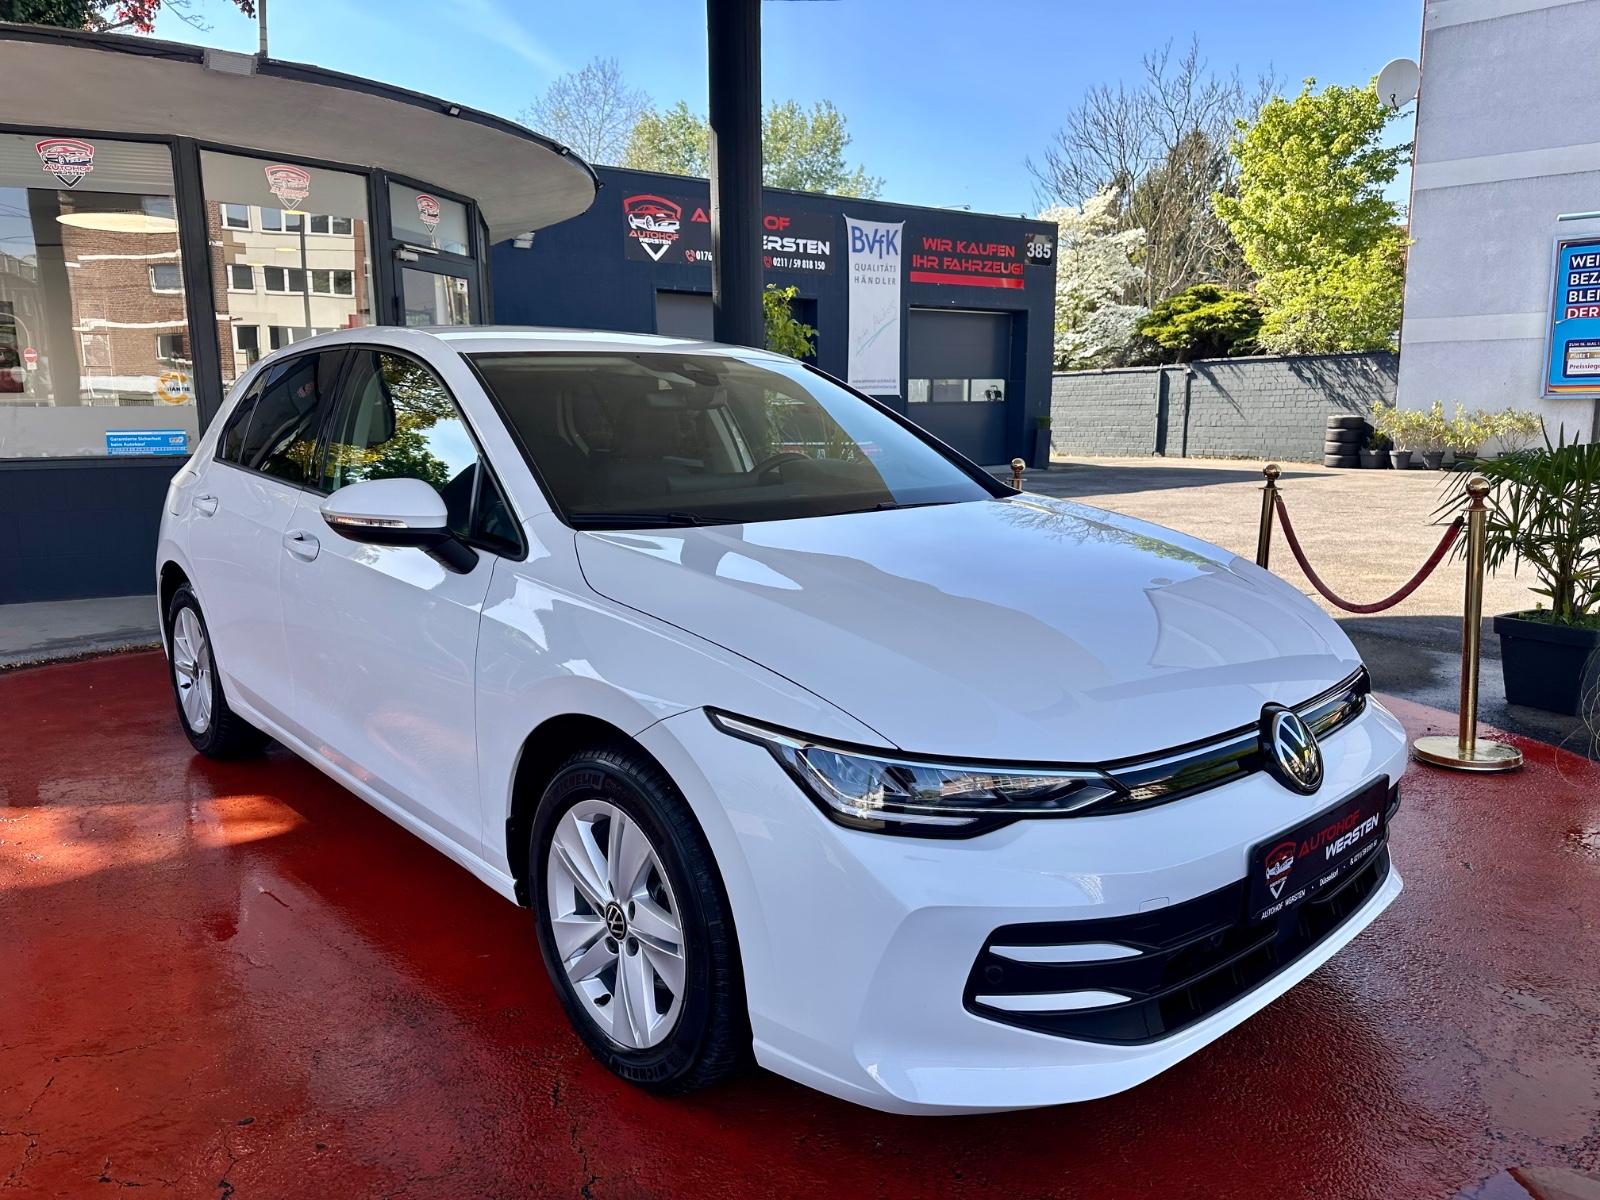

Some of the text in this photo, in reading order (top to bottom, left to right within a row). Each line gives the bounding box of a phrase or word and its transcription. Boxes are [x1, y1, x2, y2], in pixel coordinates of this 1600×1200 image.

[629, 230, 679, 241] AUTOHOF
[851, 225, 899, 260] BVfK
[763, 235, 830, 255] ERSTEN
[922, 236, 1016, 257] WIR KAUFEN
[1026, 242, 1052, 259] 385
[696, 250, 712, 261] 0176
[773, 257, 788, 267] 0211
[793, 259, 801, 268] 59
[802, 259, 814, 269] 818
[815, 260, 826, 270] 150
[854, 262, 897, 273] QUALITÄTS
[912, 254, 1024, 275] IHR FAHRZEUG!
[854, 274, 896, 285] HÄNDLER
[1570, 272, 1600, 285] BEZ
[1567, 306, 1599, 319] DER
[1298, 809, 1361, 858] AUTOHOF
[1325, 812, 1379, 860] WERSTEN
[1261, 901, 1284, 920] AUTOHOF
